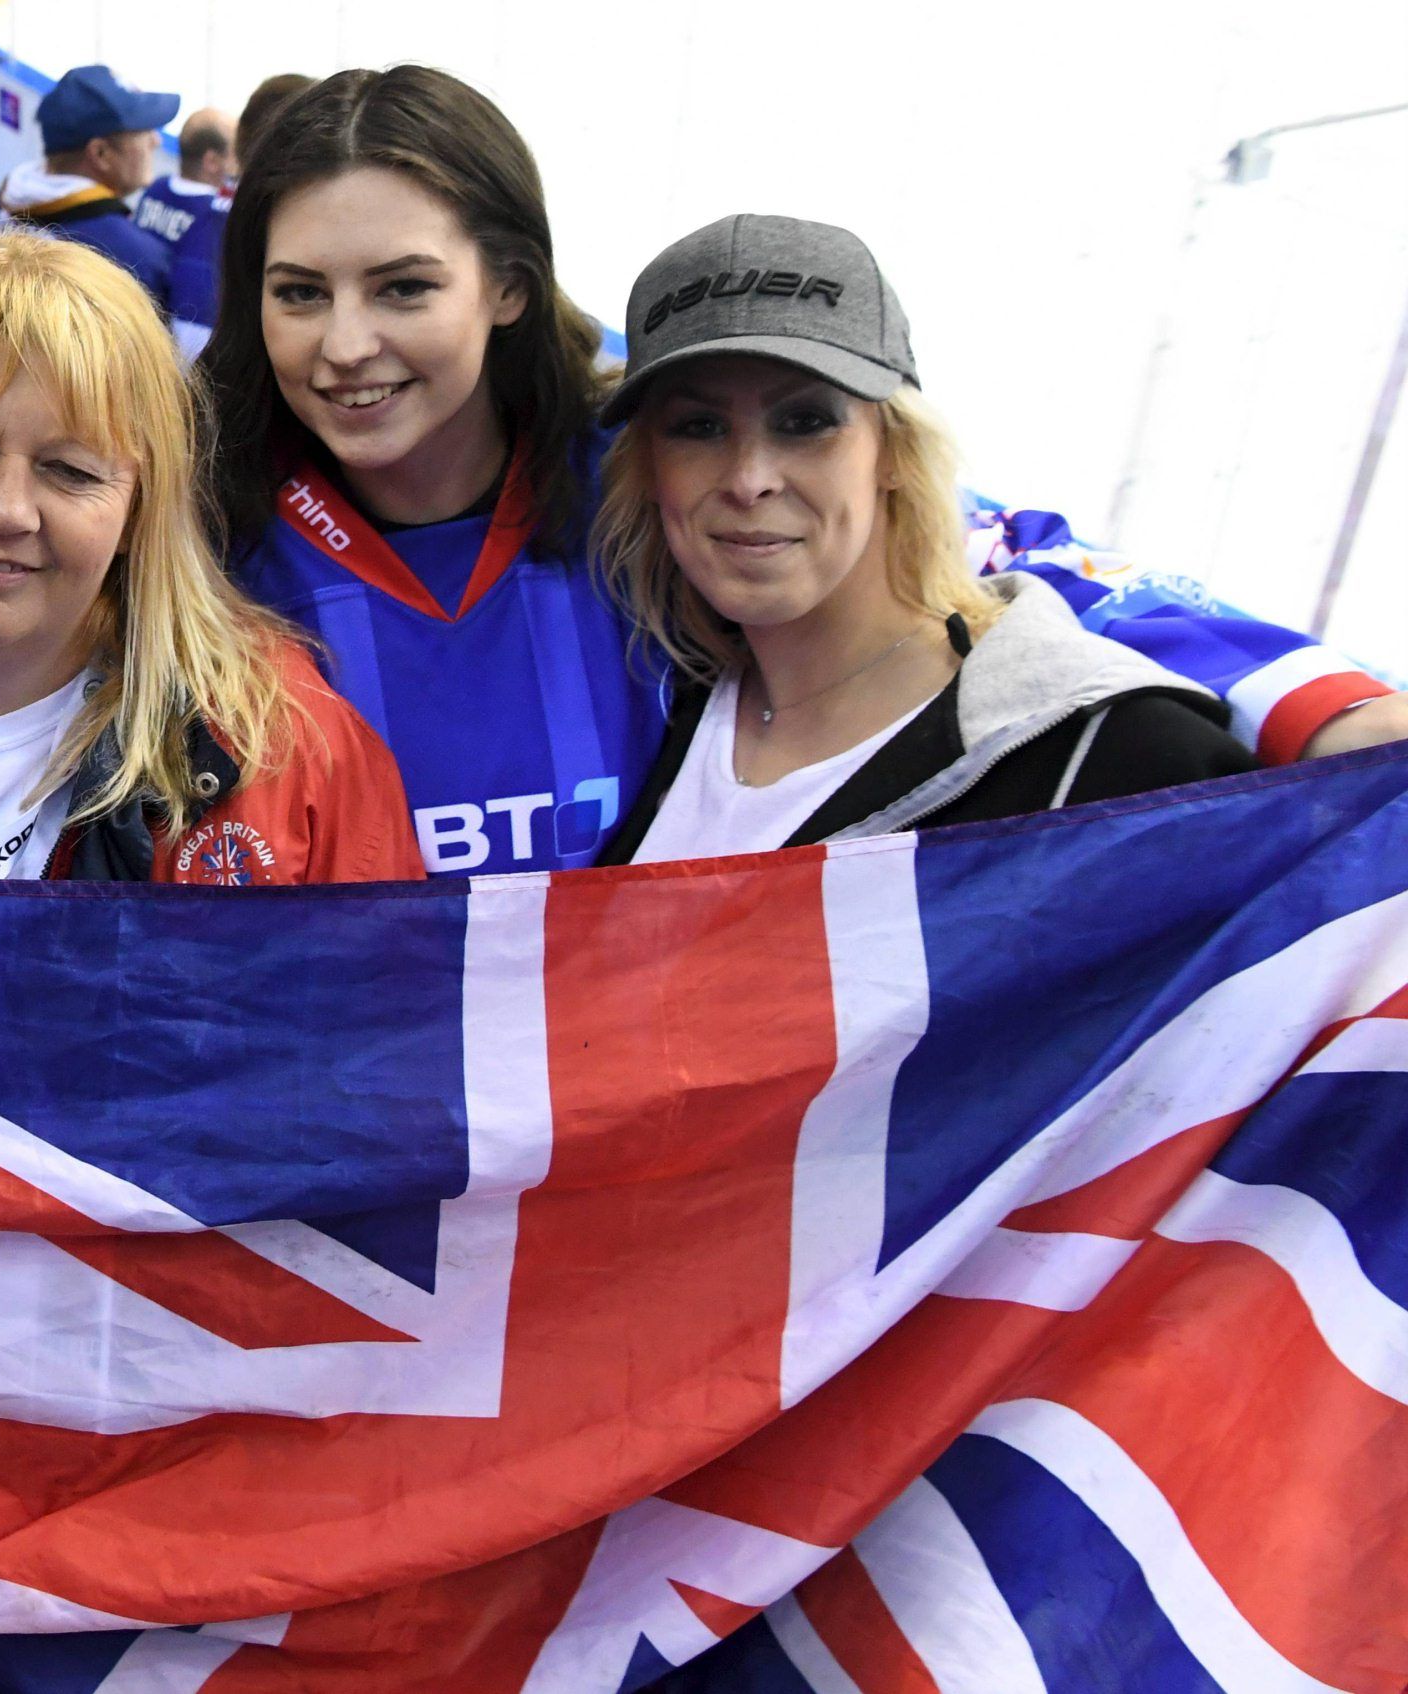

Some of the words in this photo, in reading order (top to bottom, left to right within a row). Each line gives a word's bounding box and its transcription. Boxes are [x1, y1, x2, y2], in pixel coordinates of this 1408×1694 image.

[644, 269, 844, 336] BAUER
[288, 480, 351, 552] hino
[177, 824, 214, 872] GREAT
[223, 821, 276, 868] BRITAIN
[414, 793, 554, 874] BT
